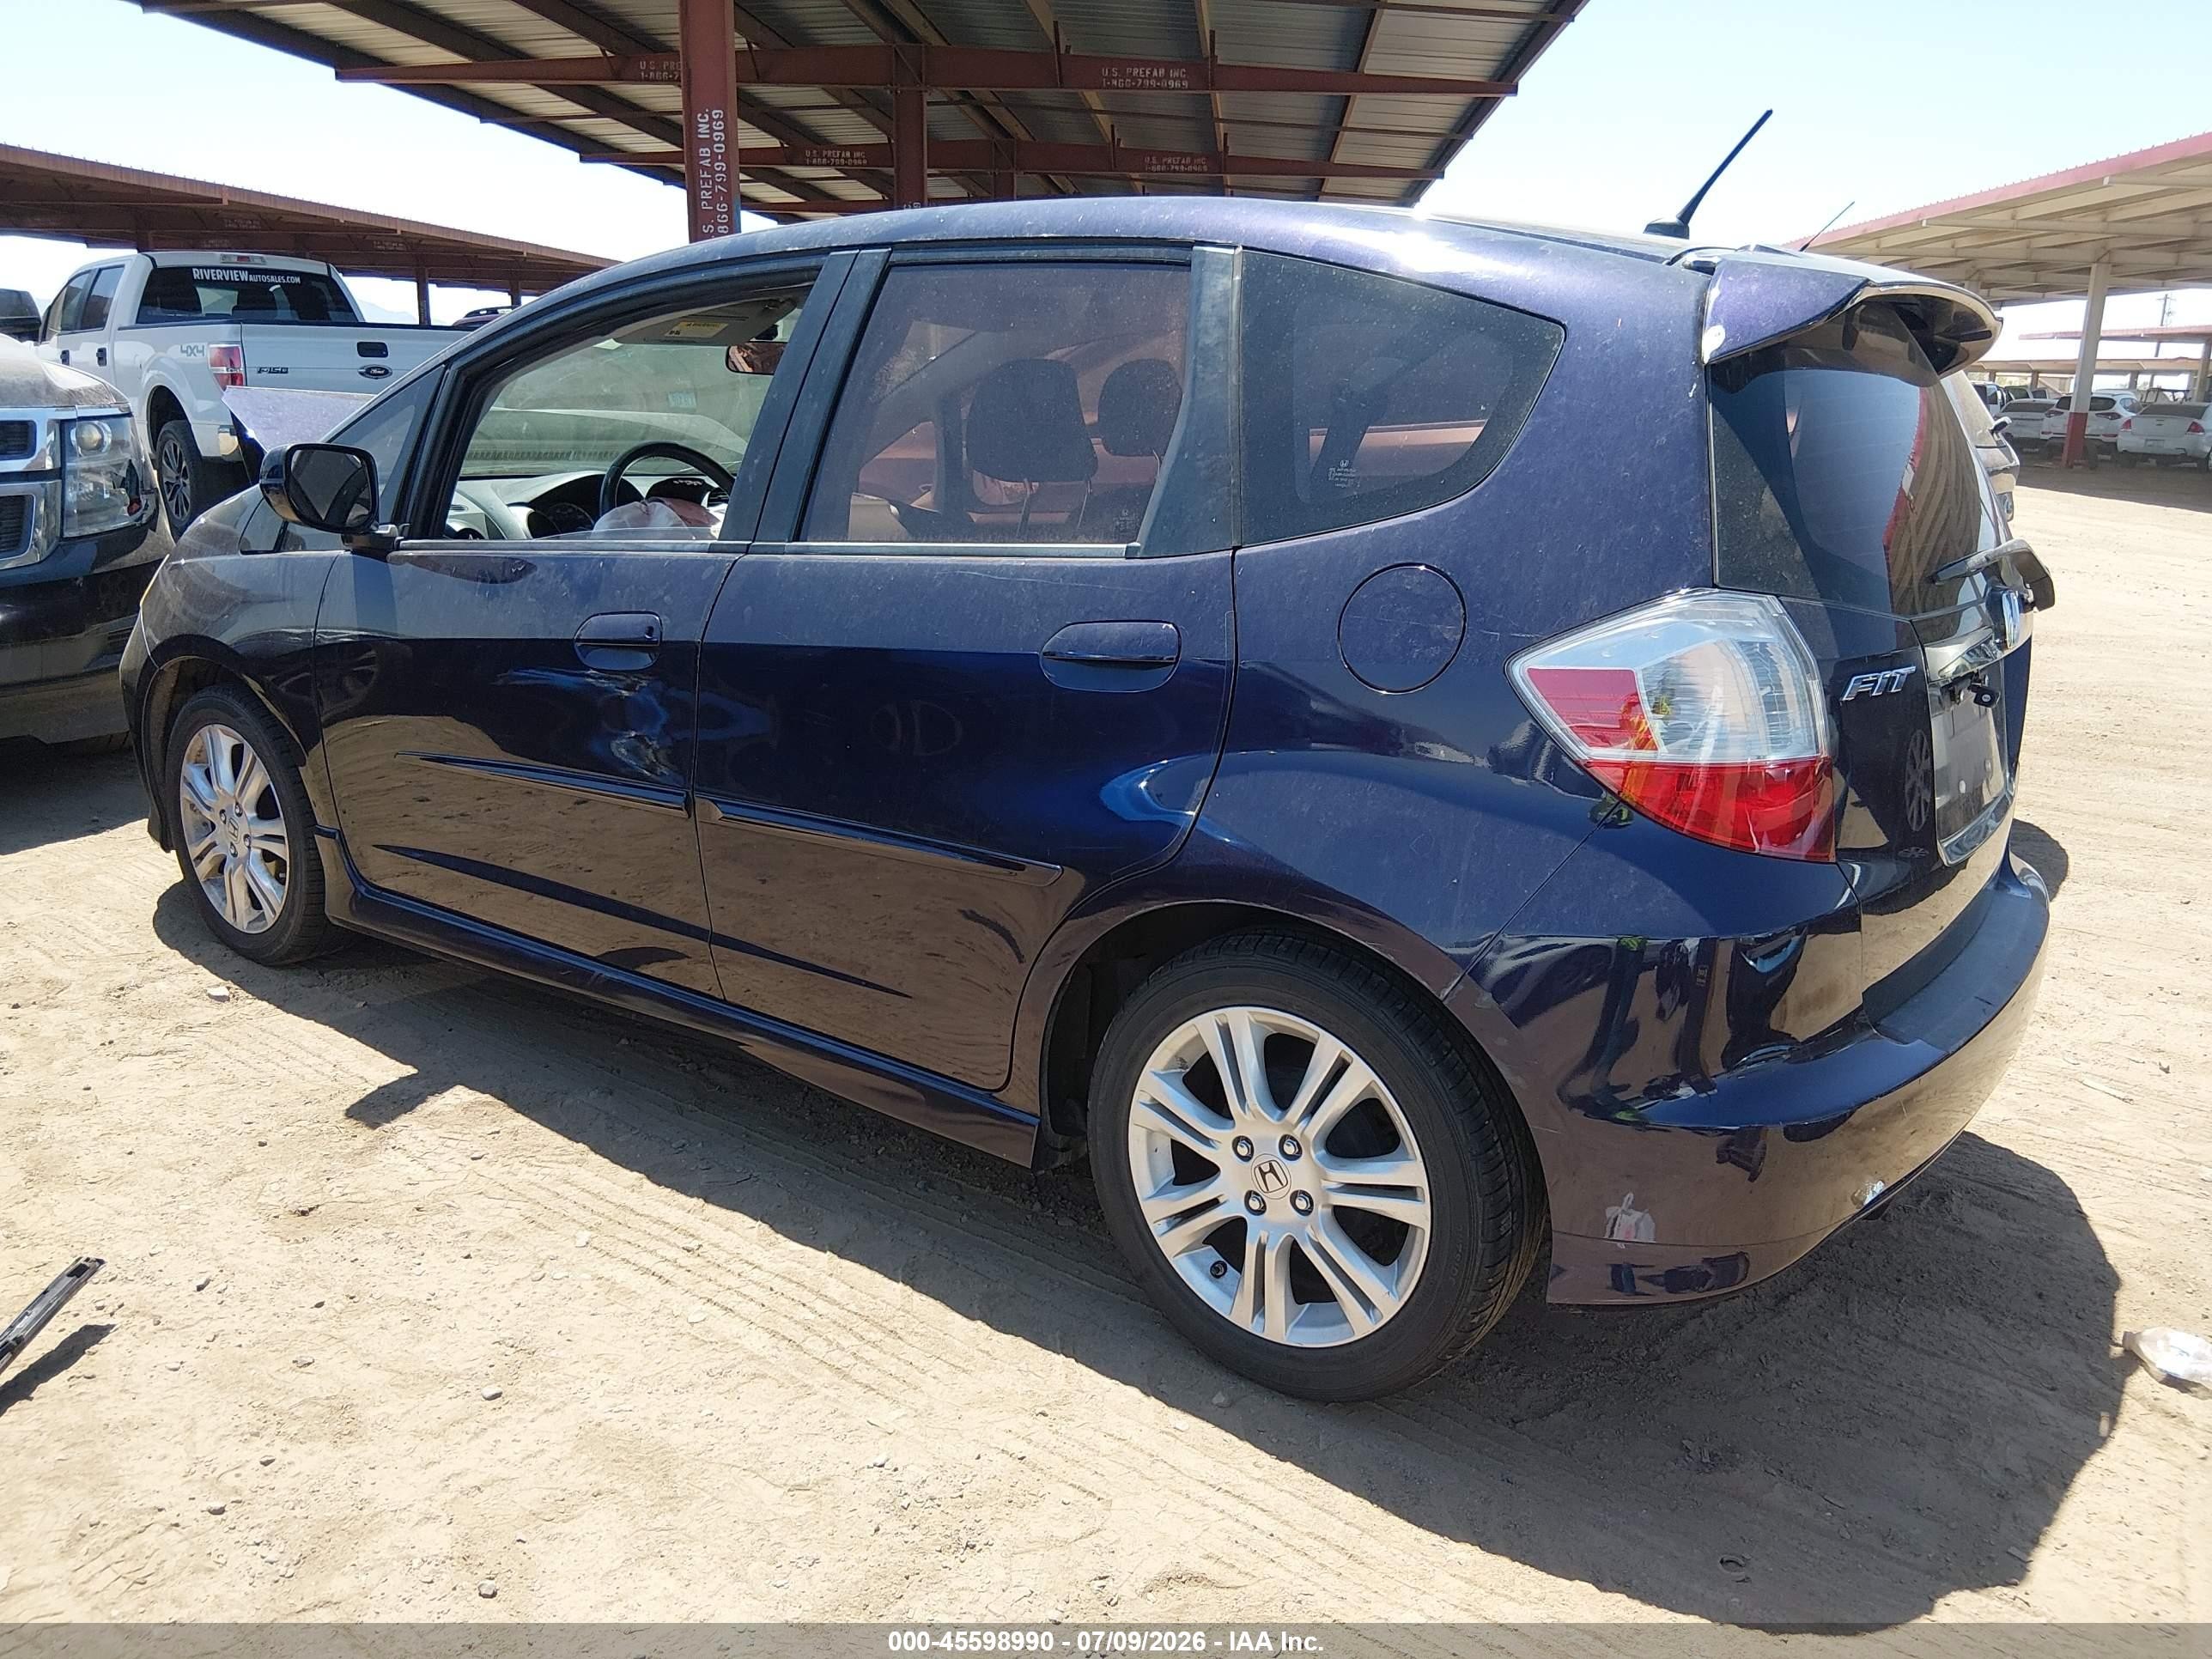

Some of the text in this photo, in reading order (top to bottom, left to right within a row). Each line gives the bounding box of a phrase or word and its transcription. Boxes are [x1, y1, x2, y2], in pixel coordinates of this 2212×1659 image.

[1126, 68, 1165, 78] PREFAB
[697, 108, 710, 139] INC.
[699, 147, 714, 210] PREFAB
[712, 109, 729, 234] 866-799-0969
